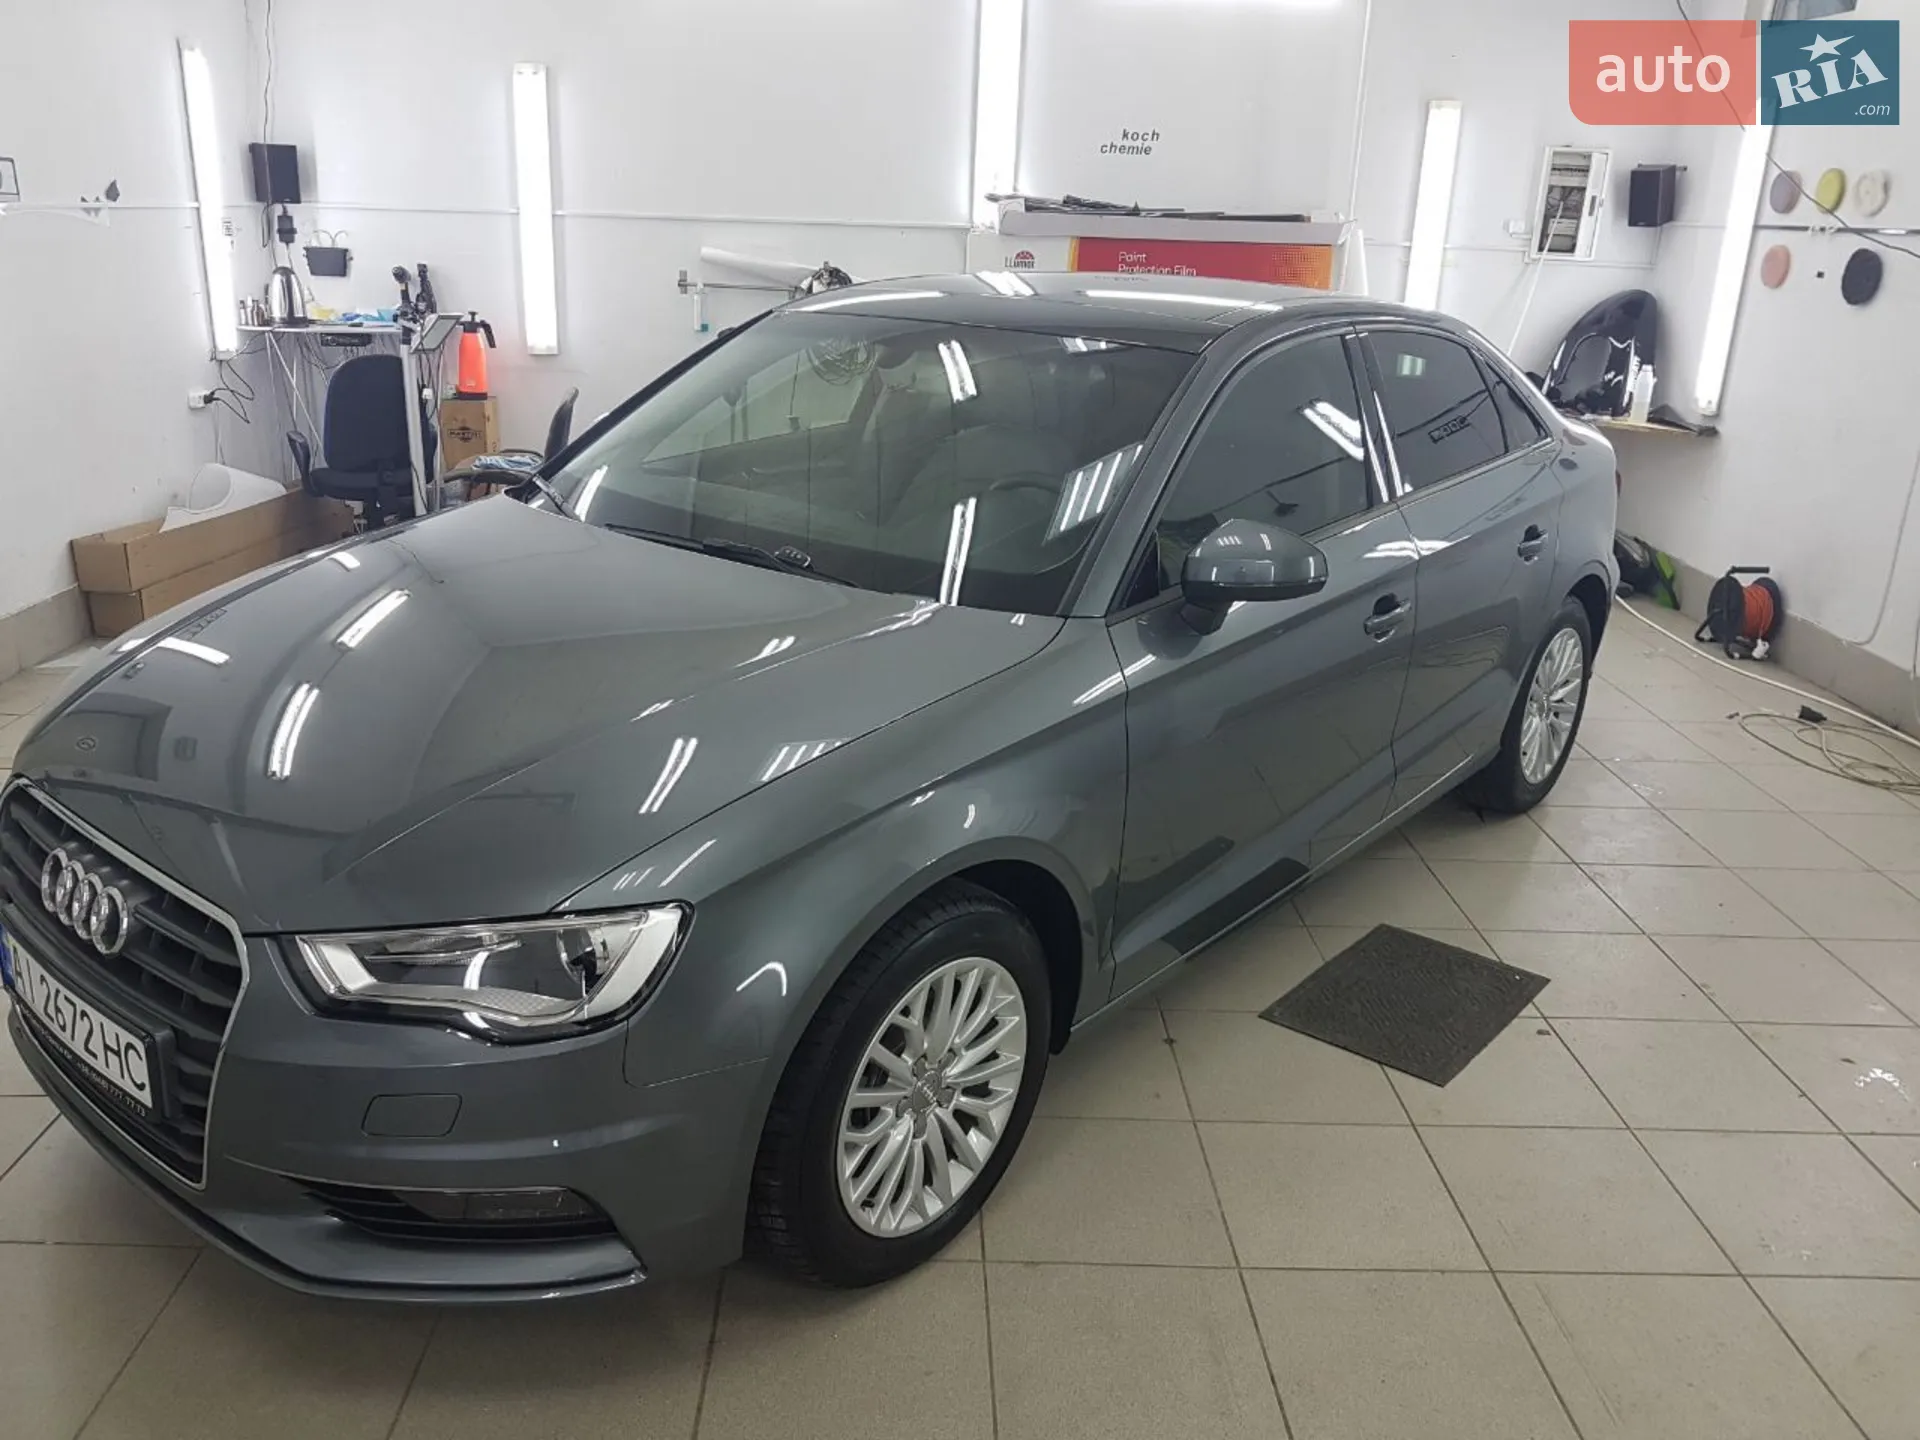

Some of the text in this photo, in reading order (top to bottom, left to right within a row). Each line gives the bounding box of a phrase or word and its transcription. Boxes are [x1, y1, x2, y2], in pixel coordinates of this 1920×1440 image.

[1121, 128, 1160, 141] koch
[1100, 141, 1152, 156] chemie
[1118, 251, 1147, 263] Paint
[1118, 263, 1197, 276] Protection Film
[13, 946, 35, 1005] AI
[40, 973, 98, 1061] 2672
[100, 1020, 146, 1092] HC
